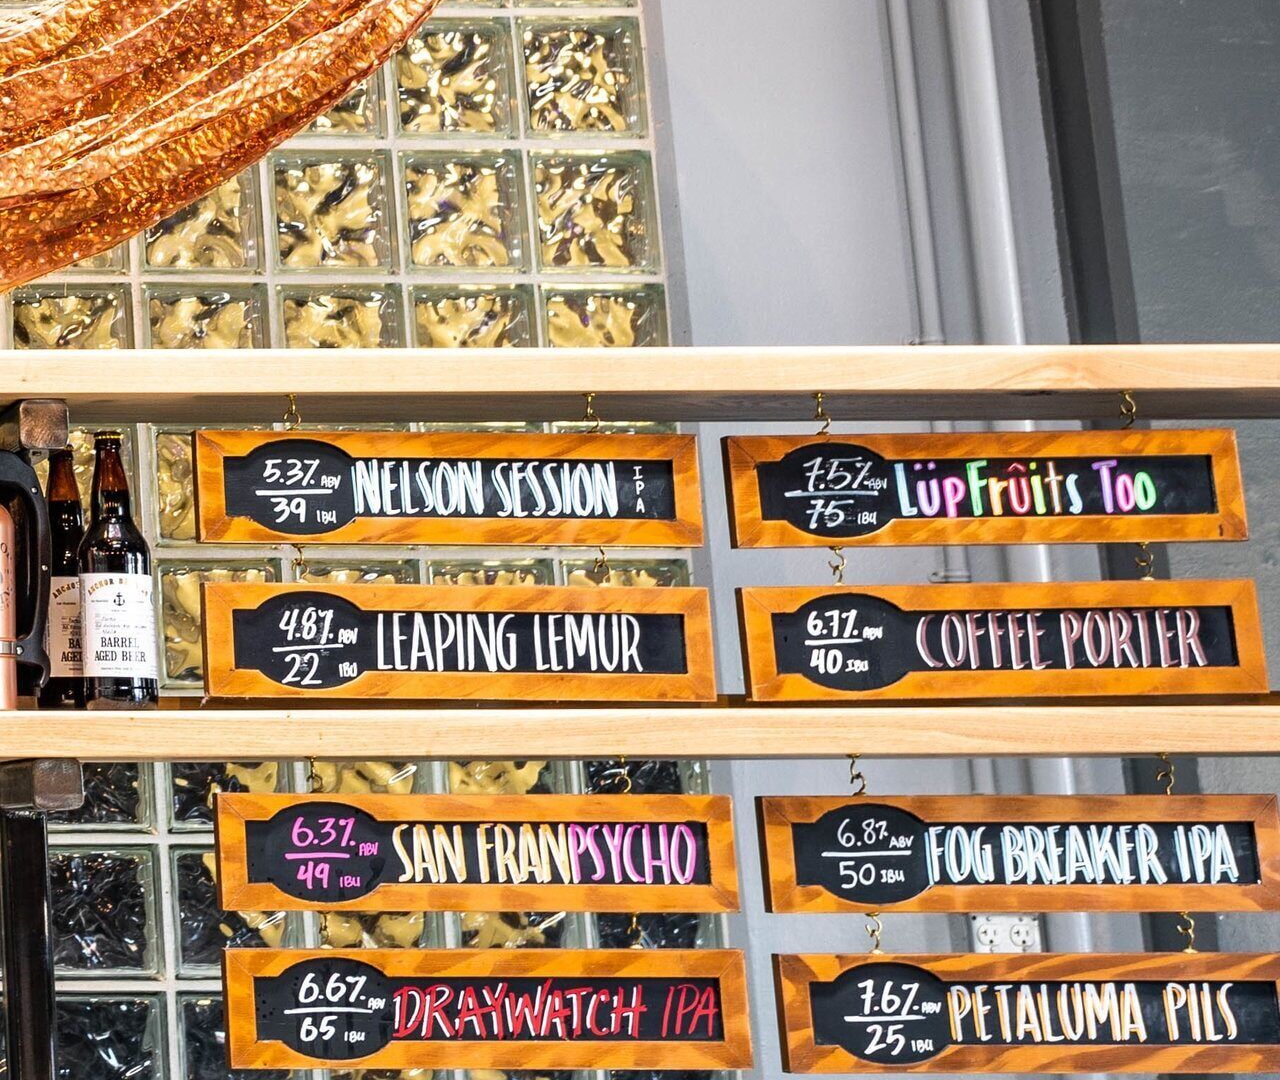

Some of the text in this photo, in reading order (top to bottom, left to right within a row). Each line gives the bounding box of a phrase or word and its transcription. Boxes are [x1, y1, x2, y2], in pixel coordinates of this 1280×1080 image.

[320, 474, 342, 490] ABV
[351, 459, 619, 518] NELSON SESSION
[868, 477, 888, 490] ABV
[1091, 459, 1157, 514] Too
[270, 497, 306, 523] 39
[805, 499, 855, 530] 75
[338, 627, 359, 645] ABV
[377, 612, 644, 672] LEAPING LEMUR
[862, 626, 884, 641] ABV
[916, 608, 1208, 670] COFFEE PORTER
[94, 650, 117, 662] AGED
[281, 652, 323, 686] 22
[809, 648, 843, 675] 40
[358, 841, 379, 857] ABV
[392, 822, 697, 885] SAN FRANPSYCHO
[888, 835, 914, 849] ABV
[924, 823, 1240, 886] FOG BREAKER IPA
[296, 860, 330, 890] 49
[839, 860, 876, 889] 50
[367, 997, 386, 1010] ABV
[392, 978, 717, 1039] DRAYWATCH IPA
[921, 1001, 942, 1014] ABV
[946, 982, 1238, 1043] PETALUMA PILS
[300, 1015, 338, 1042] 65
[863, 1024, 906, 1056] 25
